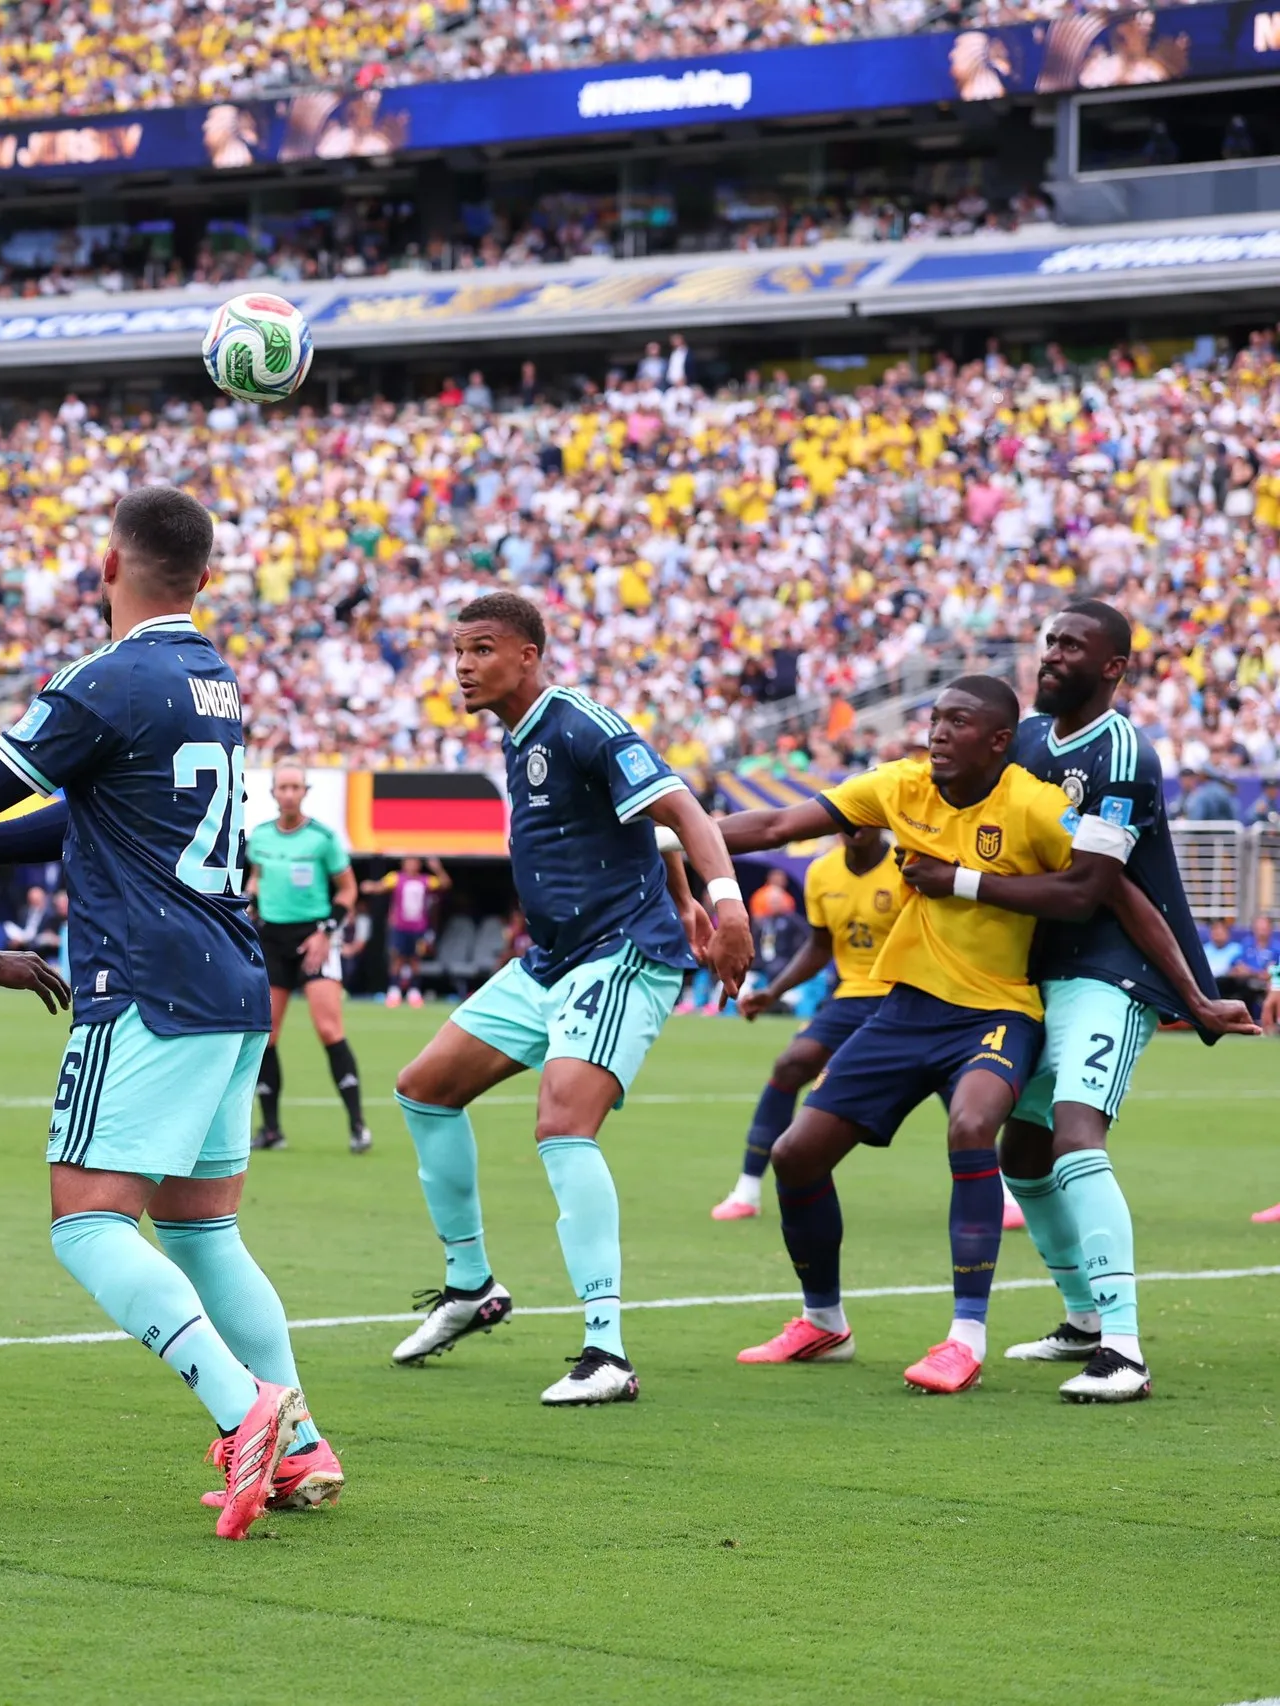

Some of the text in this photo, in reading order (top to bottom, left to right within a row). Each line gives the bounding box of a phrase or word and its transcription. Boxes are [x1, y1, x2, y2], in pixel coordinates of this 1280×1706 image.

[981, 1025, 1007, 1051] 4
[1084, 1033, 1115, 1073] 2
[585, 1278, 612, 1293] DFB
[141, 1325, 161, 1350] FB
